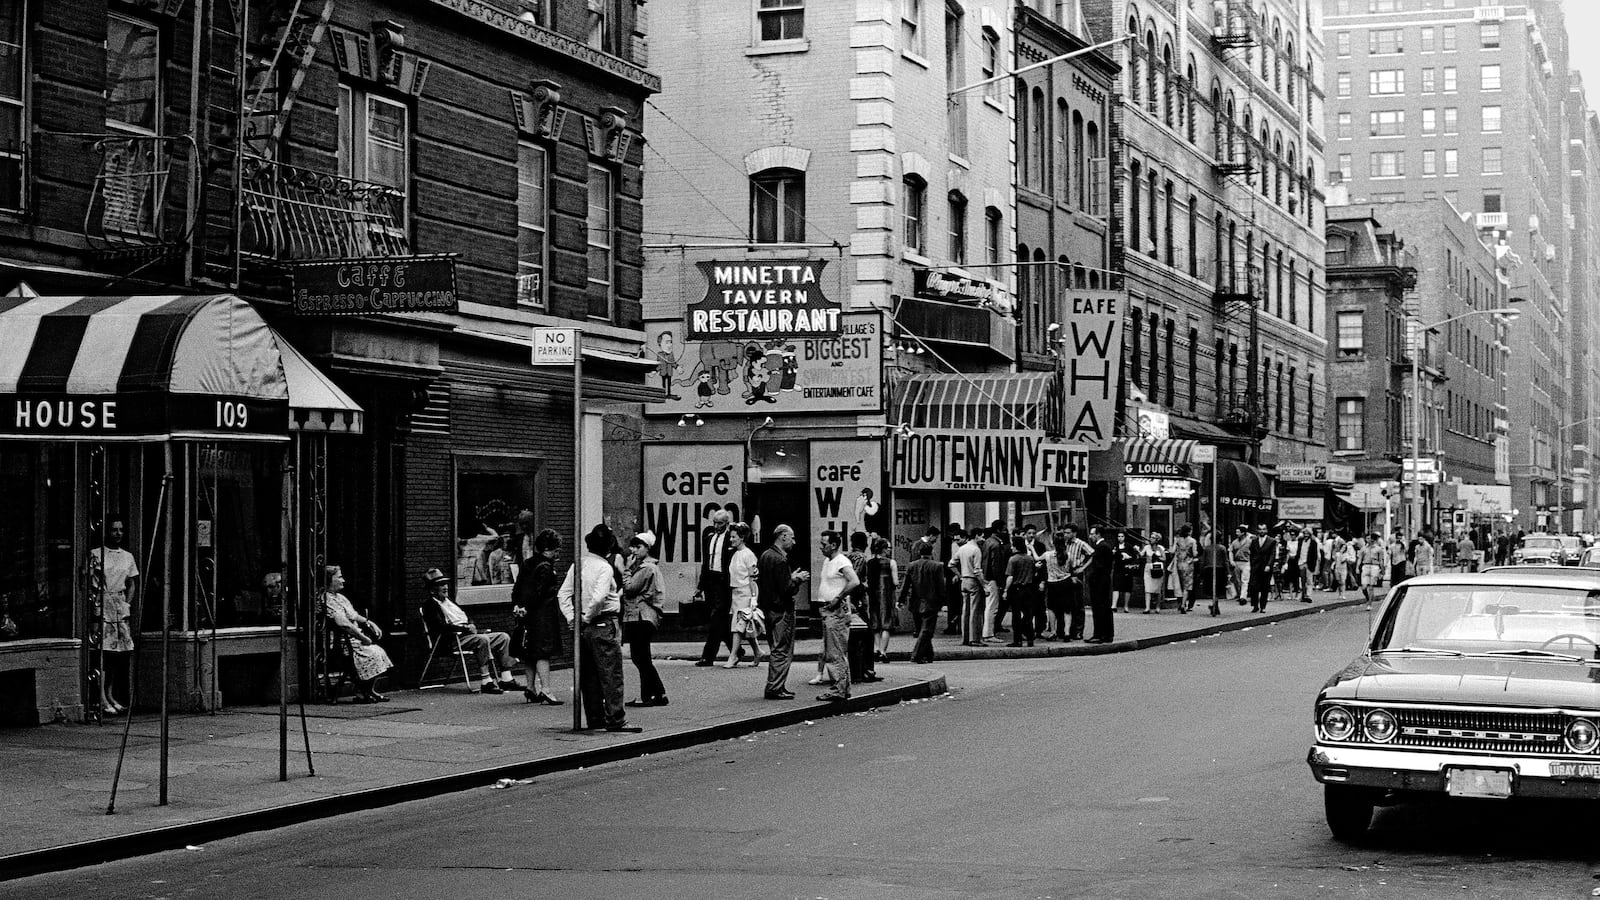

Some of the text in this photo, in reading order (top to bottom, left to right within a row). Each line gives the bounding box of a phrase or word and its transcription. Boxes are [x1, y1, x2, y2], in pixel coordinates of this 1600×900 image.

[714, 266, 816, 285] MINETTA
[722, 289, 808, 305] TAVERN
[1073, 298, 1116, 315] CAFE
[693, 308, 841, 333] RESTAURANT
[545, 332, 566, 344] NO
[537, 346, 573, 357] PARKING
[804, 337, 872, 361] BIGGEST
[803, 386, 856, 398] ENTERTAINMENT
[16, 400, 118, 429] HOUSE
[216, 401, 249, 428] 109
[892, 433, 1044, 489] HOOTENANNY
[1041, 449, 1088, 485] FREE
[1138, 463, 1179, 474] LOUNGE
[945, 482, 986, 490] TONITE
[1232, 497, 1257, 508] CAFFE
[895, 508, 926, 526] FREE
